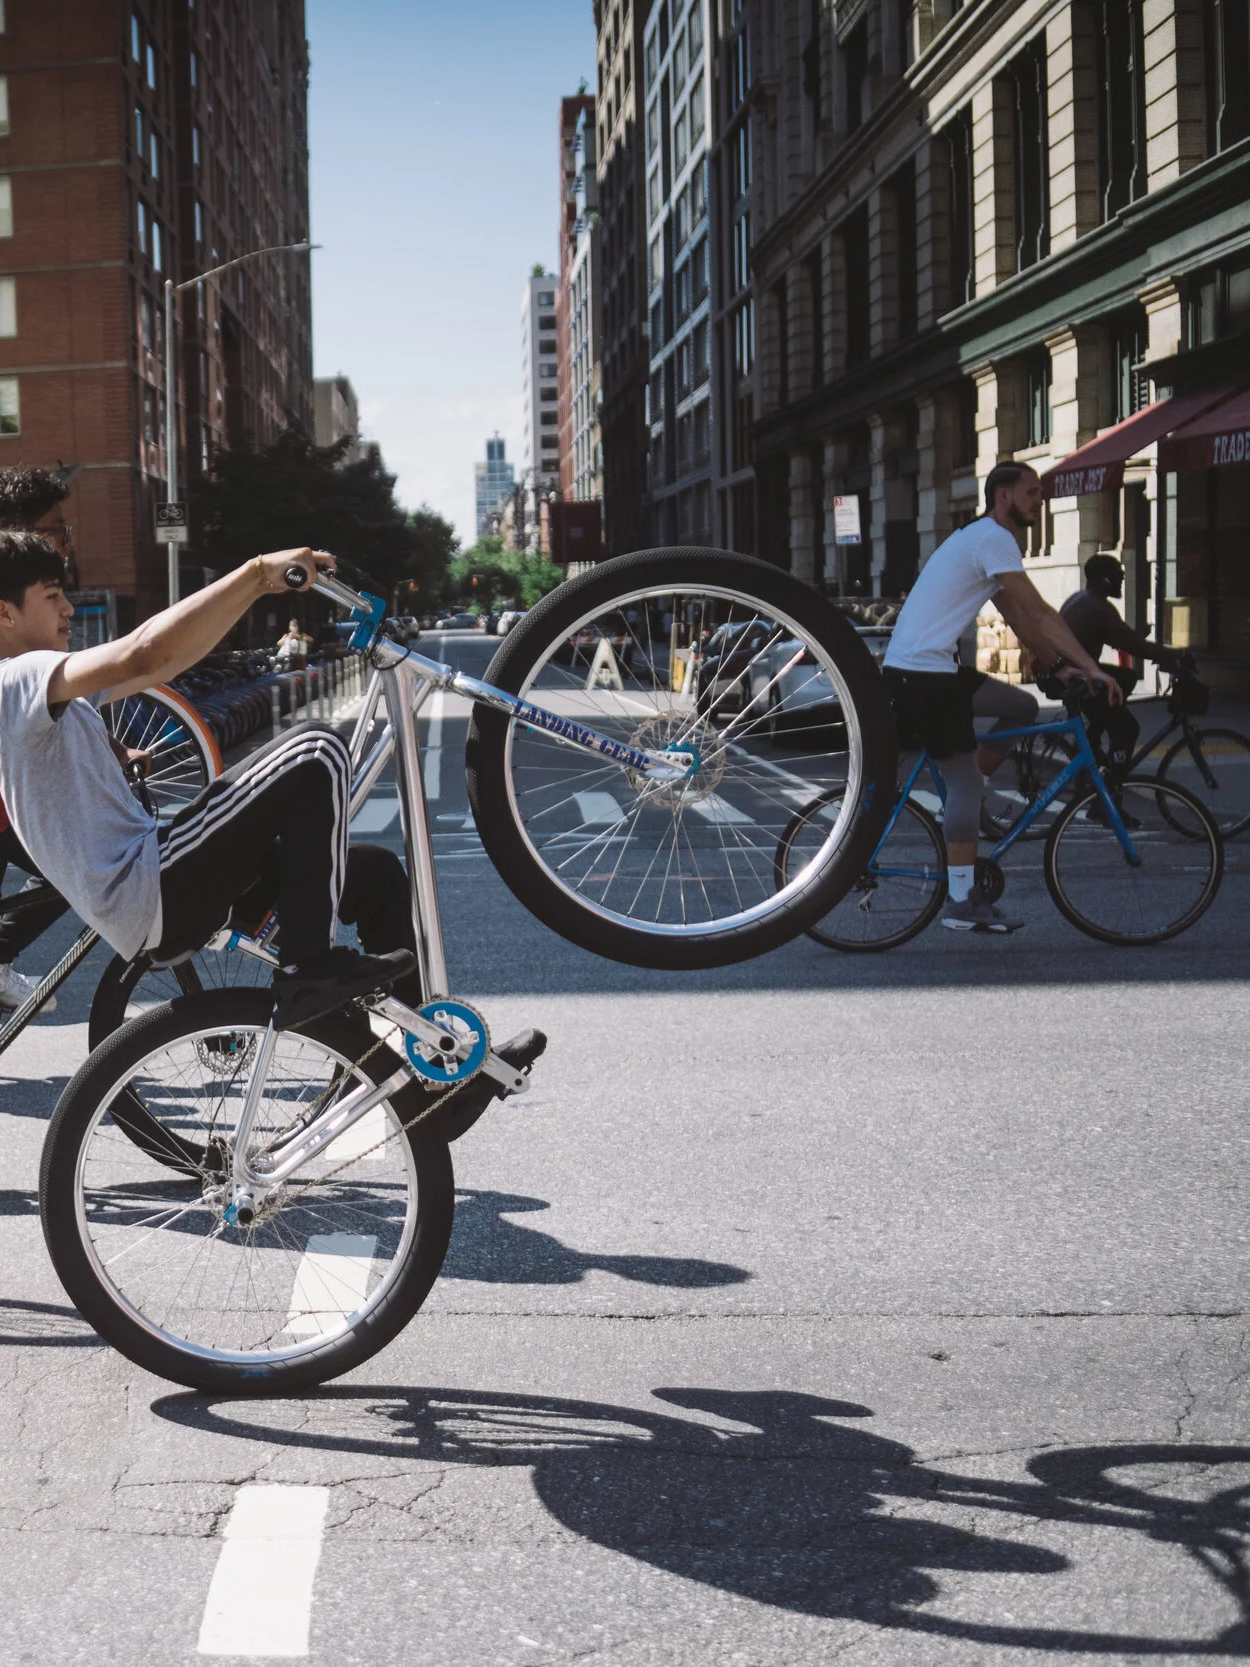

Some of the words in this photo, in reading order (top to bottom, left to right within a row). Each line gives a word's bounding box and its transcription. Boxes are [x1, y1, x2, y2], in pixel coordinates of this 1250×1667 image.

[1213, 431, 1250, 464] TRADE
[1054, 473, 1084, 497] TRADER
[514, 701, 596, 746] LANDING
[600, 739, 651, 770] GEAR
